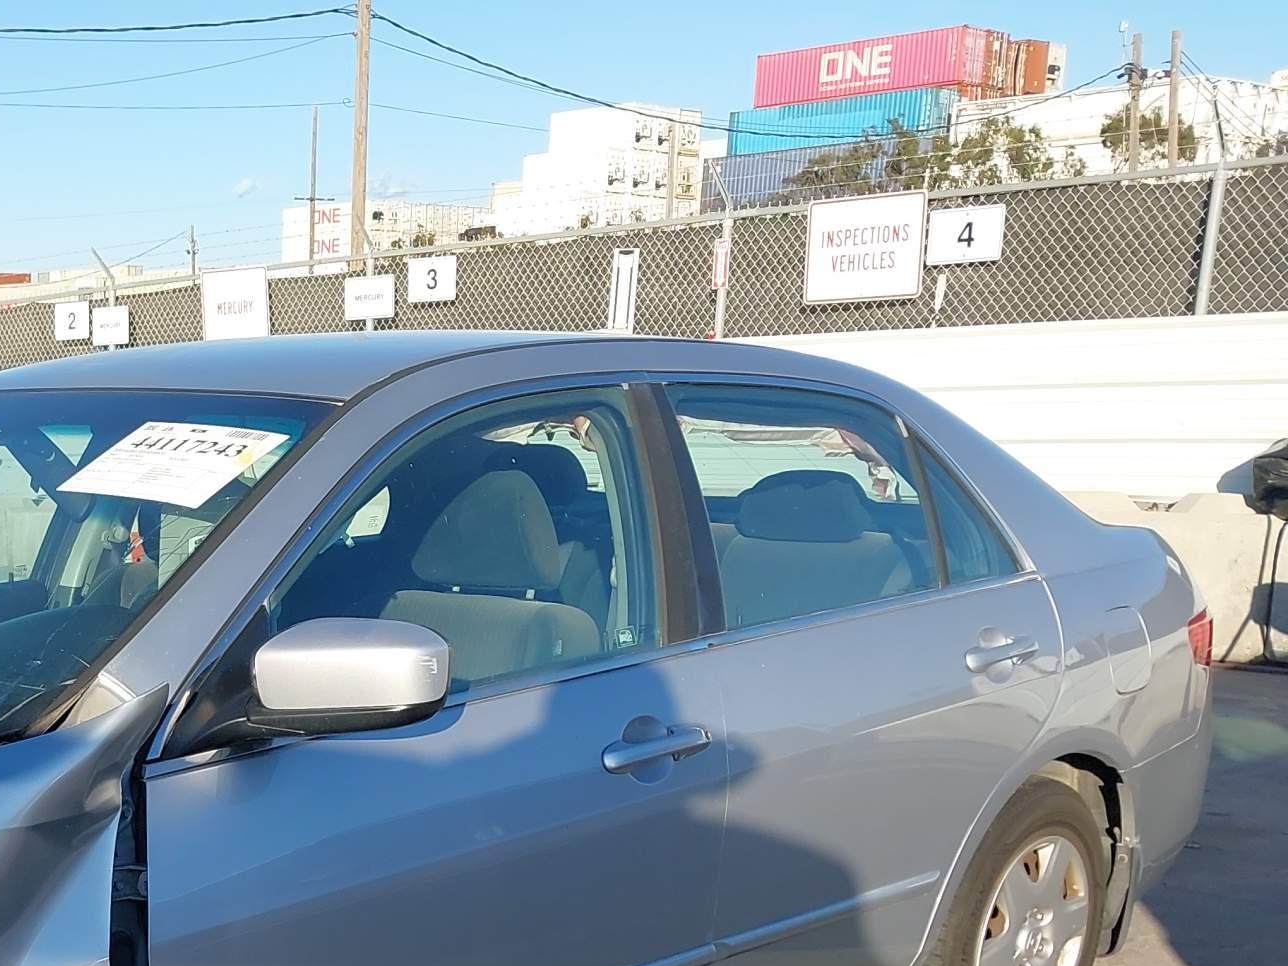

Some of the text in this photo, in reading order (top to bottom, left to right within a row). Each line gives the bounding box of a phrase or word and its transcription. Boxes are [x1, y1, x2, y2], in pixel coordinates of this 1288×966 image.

[819, 44, 893, 83] ONE
[821, 223, 910, 248] INSPECTIONS
[957, 222, 975, 248] 4
[831, 251, 896, 272] VEHICLES
[426, 268, 438, 290] 3
[354, 293, 385, 302] MERCURY
[217, 301, 254, 316] MERCURY
[67, 312, 77, 330] 2
[131, 436, 249, 457] 44117243
